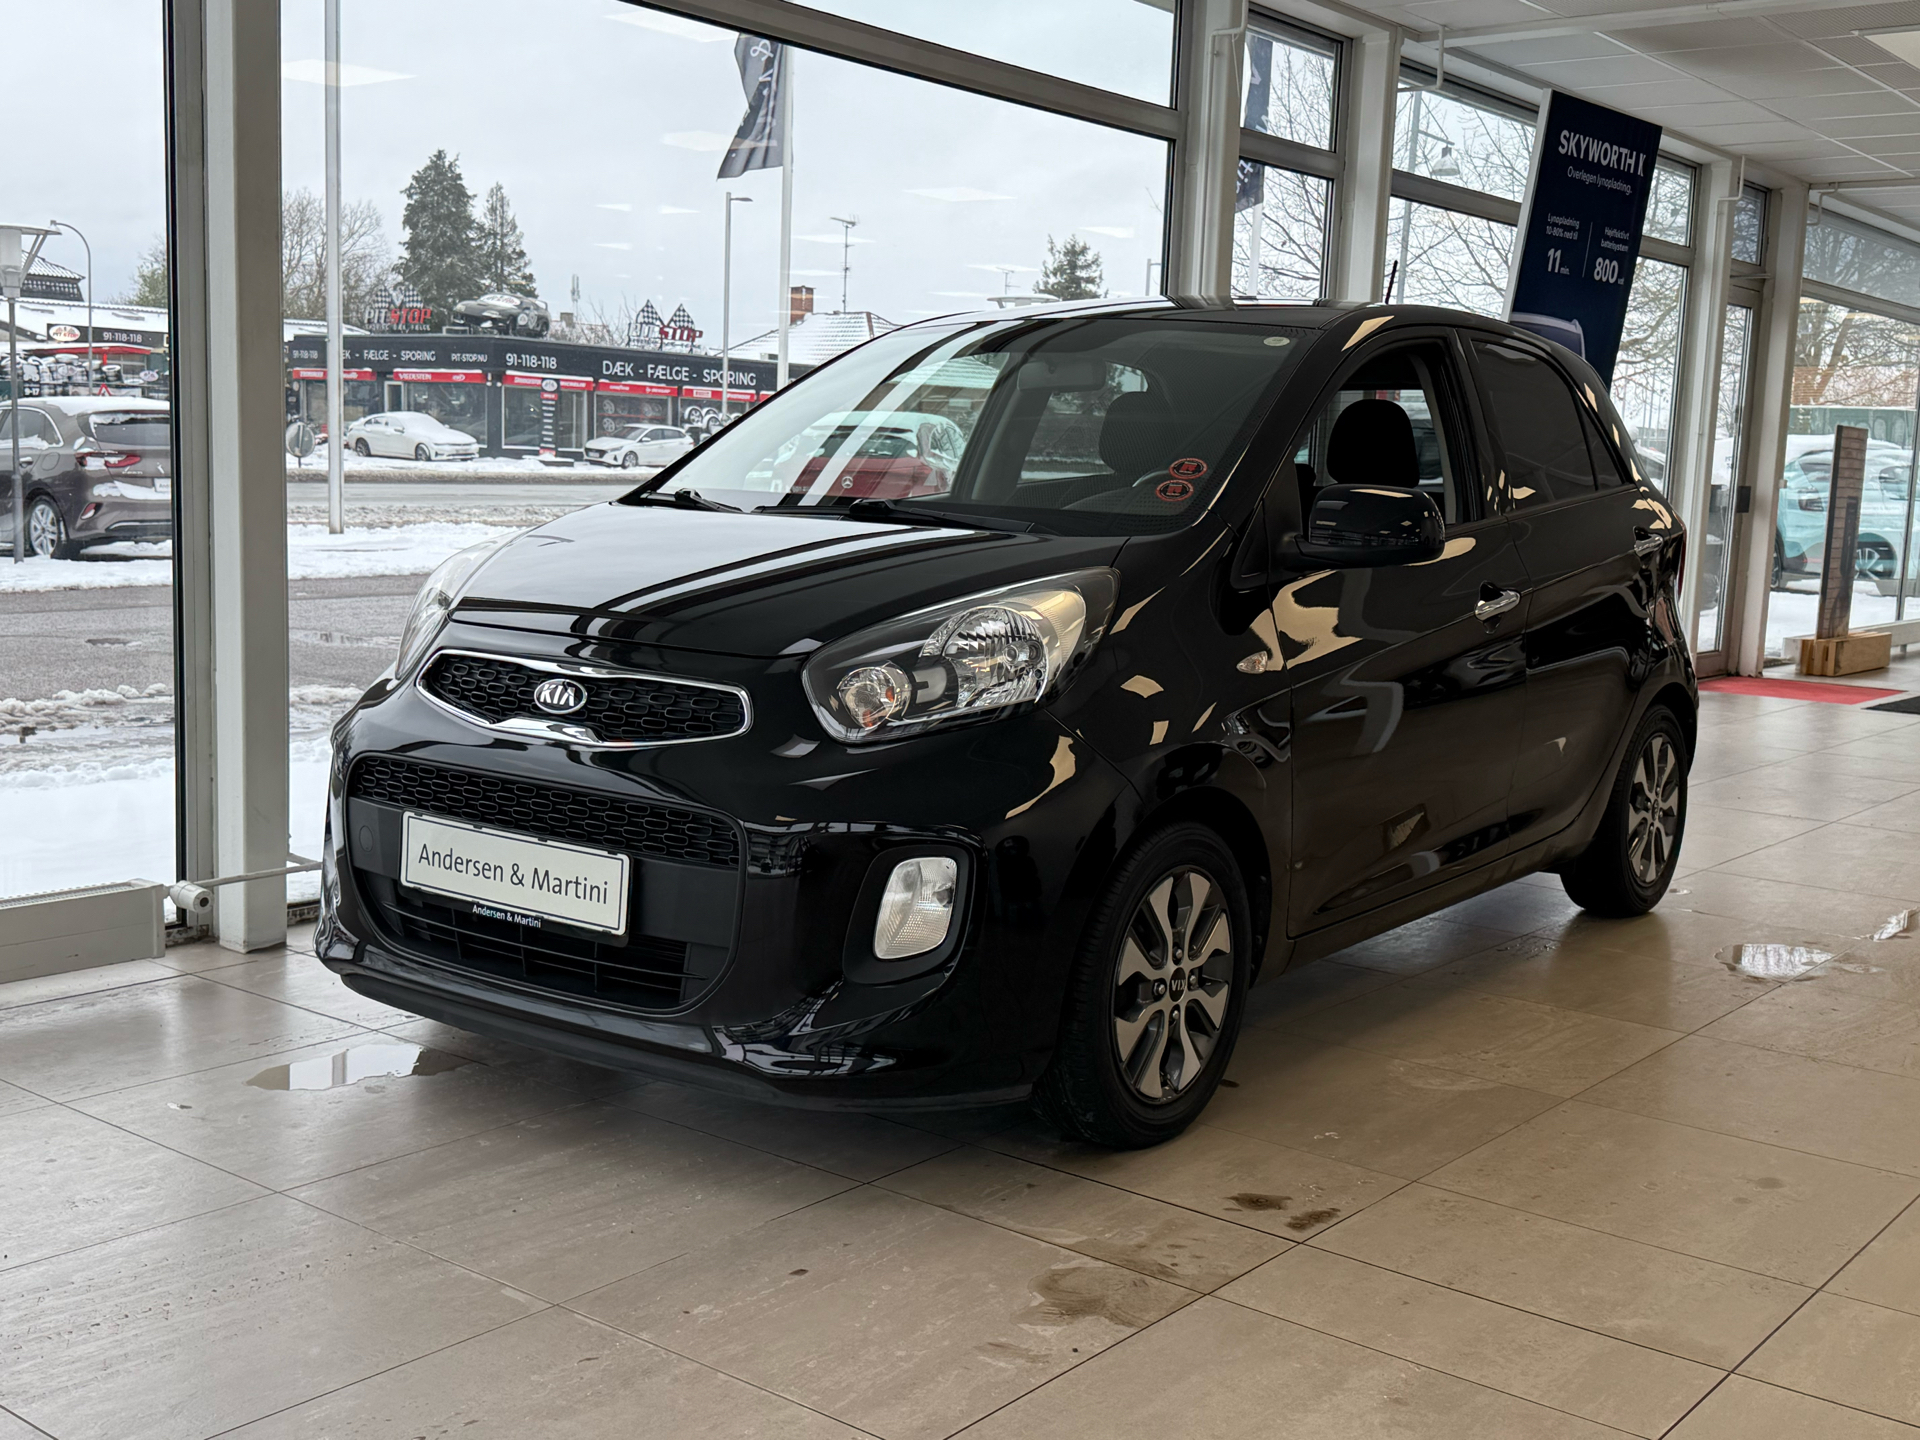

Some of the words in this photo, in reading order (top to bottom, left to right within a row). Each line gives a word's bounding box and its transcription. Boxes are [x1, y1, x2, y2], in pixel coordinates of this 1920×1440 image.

[1558, 129, 1636, 174] SKYWORTH
[1567, 166, 1596, 184] Overlegen
[1547, 248, 1561, 273] 11
[1594, 257, 1619, 284] 800
[364, 308, 389, 324] PIT
[390, 308, 432, 324] STOP
[103, 331, 142, 343] 91-118-118
[659, 325, 703, 342] STOP
[363, 350, 389, 361] FÆLGE
[401, 351, 436, 362] SPORING
[505, 353, 558, 369] 91-118-118
[602, 360, 634, 377] DÆK
[647, 364, 690, 382] FÆLGE
[539, 682, 576, 706] KIA
[418, 843, 504, 884] Andersen
[509, 862, 525, 887] &
[531, 867, 609, 905] Martini
[472, 904, 506, 920] Andersen
[506, 911, 513, 922] &
[514, 913, 542, 928] Martini
